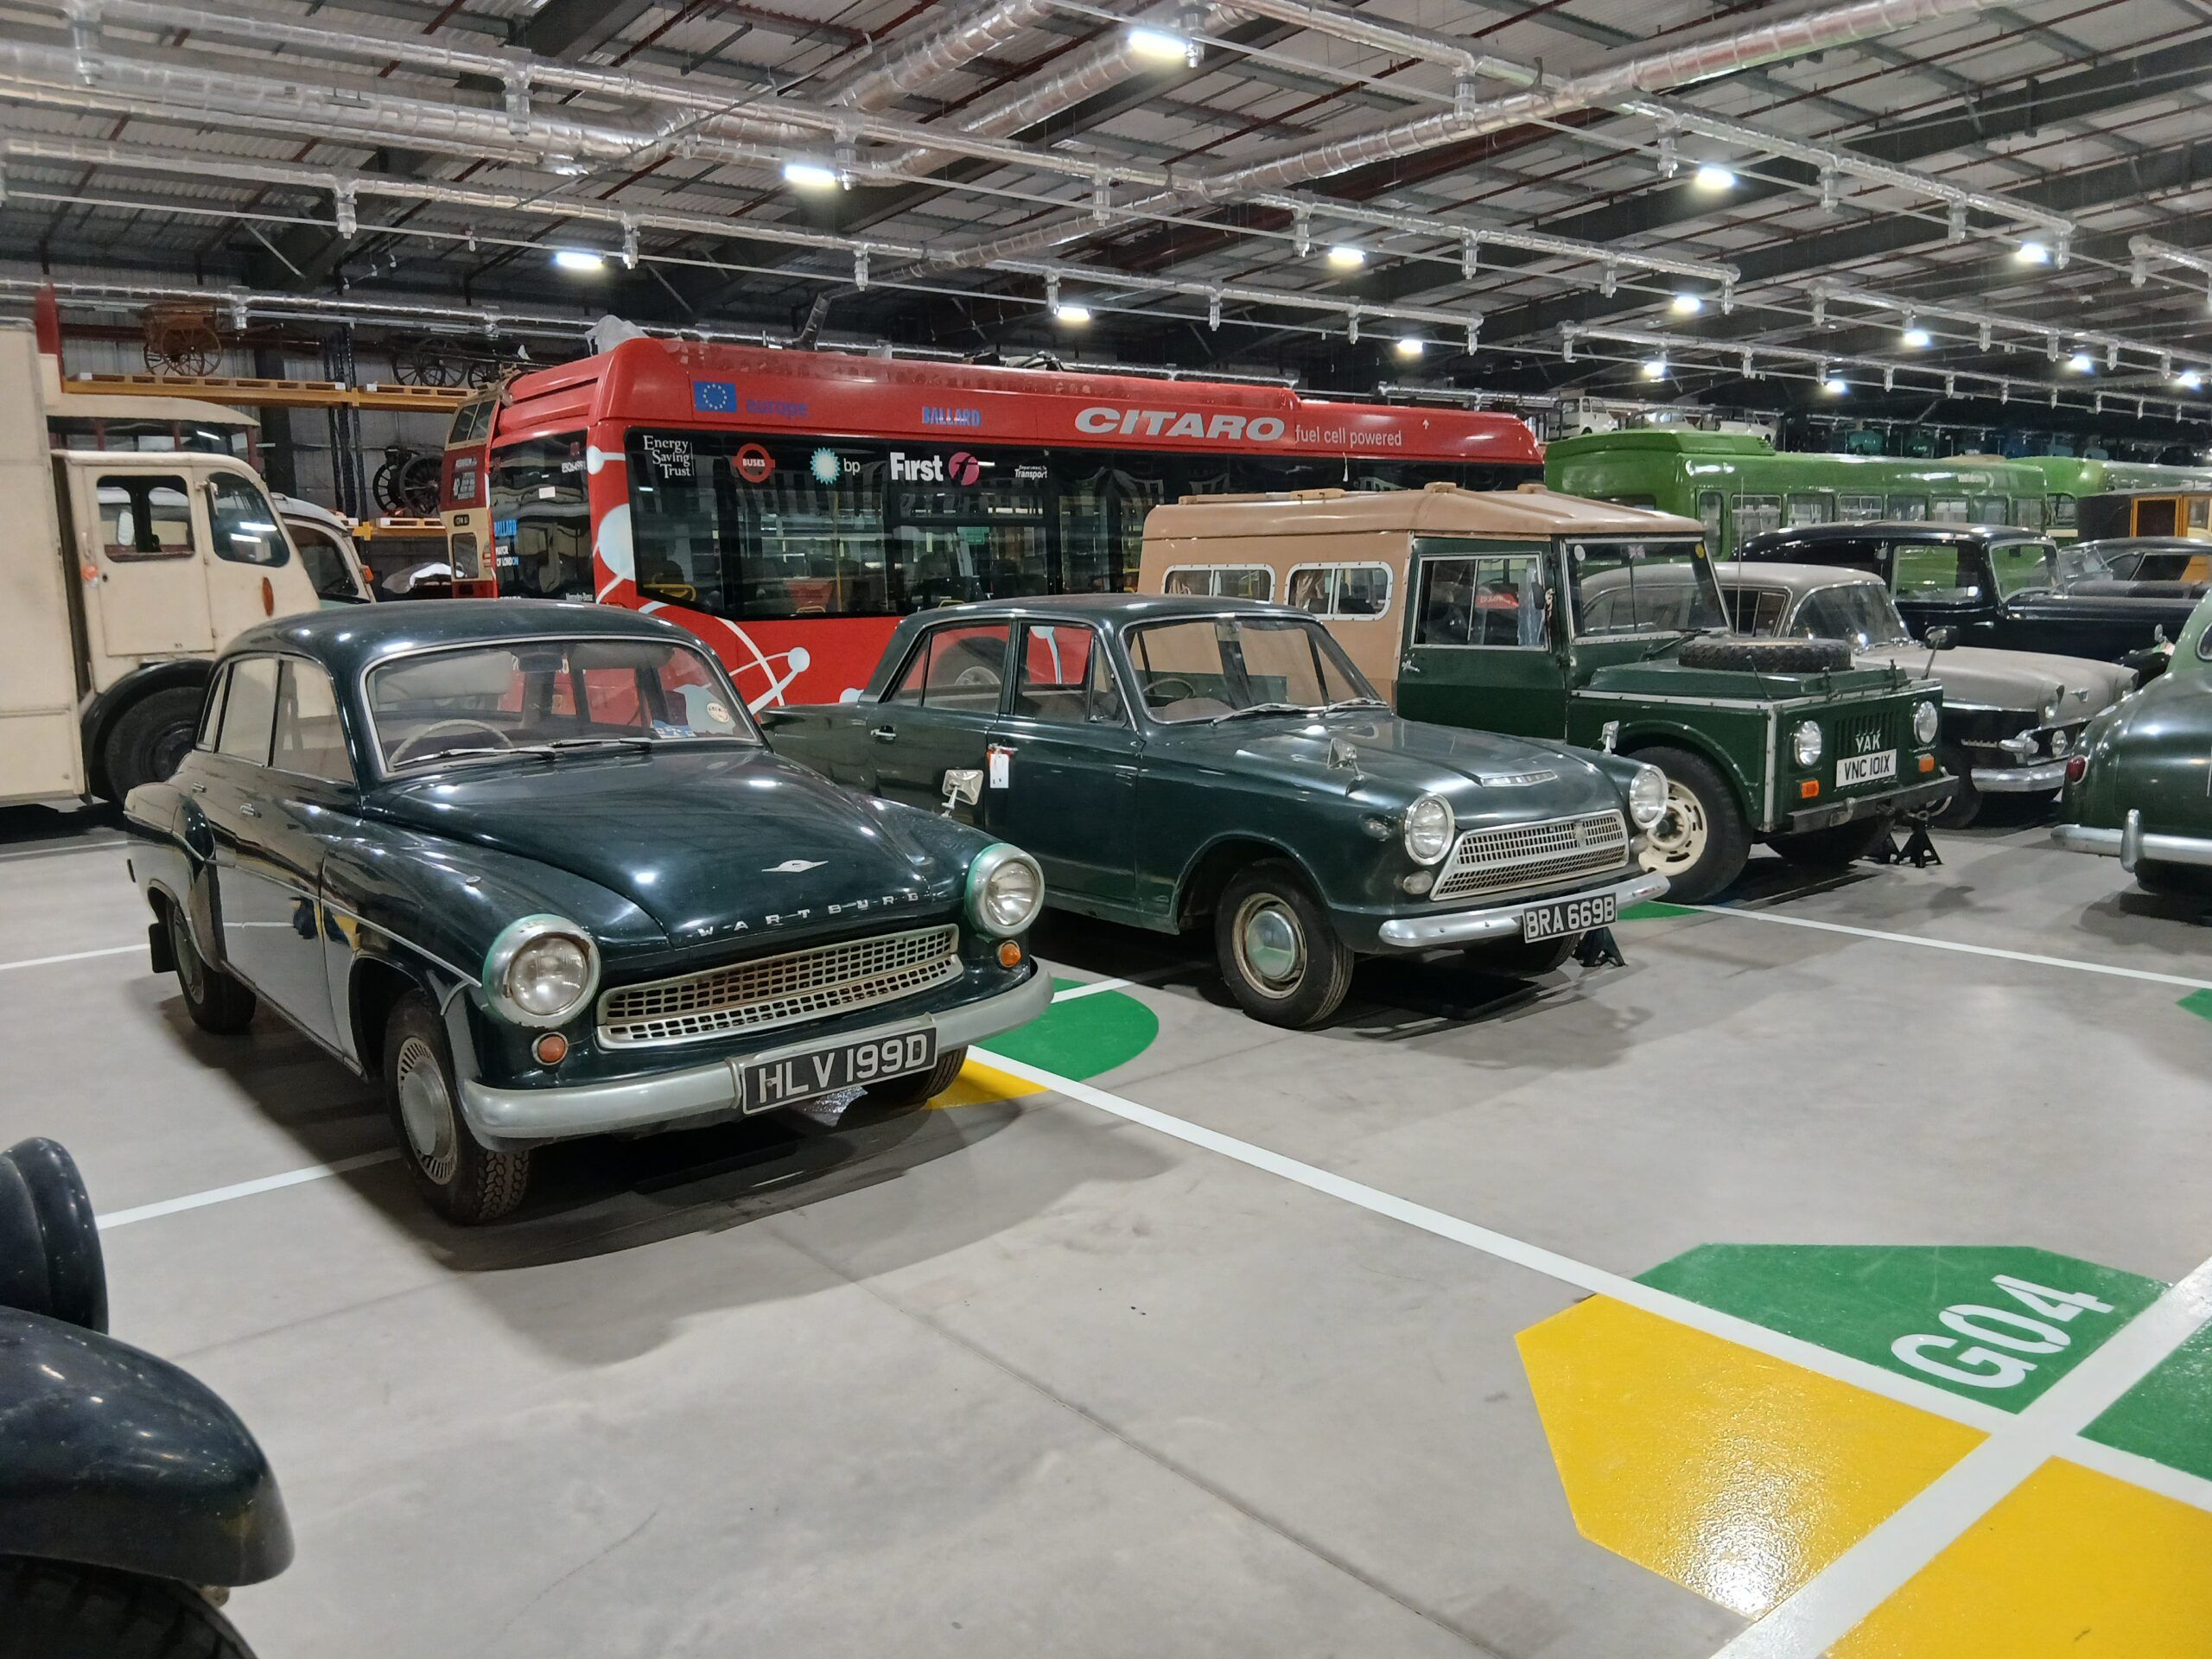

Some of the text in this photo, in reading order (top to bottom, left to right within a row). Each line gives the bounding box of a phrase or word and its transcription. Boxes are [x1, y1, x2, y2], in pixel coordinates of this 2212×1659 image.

[746, 399, 809, 419] europe
[921, 406, 982, 427] BALLARD
[1074, 406, 1285, 442] CITARO
[643, 435, 689, 454] Energy
[1295, 424, 1402, 448] fuel cell powered
[652, 449, 690, 467] Saving
[742, 458, 766, 467] BUSES
[843, 457, 861, 476] bp
[890, 451, 944, 482] First
[660, 463, 691, 479] Trust
[1014, 468, 1048, 480] Transport
[1855, 733, 1881, 753] YAK
[1844, 754, 1891, 781] VNC 101X
[696, 892, 918, 938] WARTBURG
[1526, 896, 1616, 939] BRA 669B
[759, 1033, 928, 1104] HLV 199D
[1891, 1274, 2116, 1389] G04
